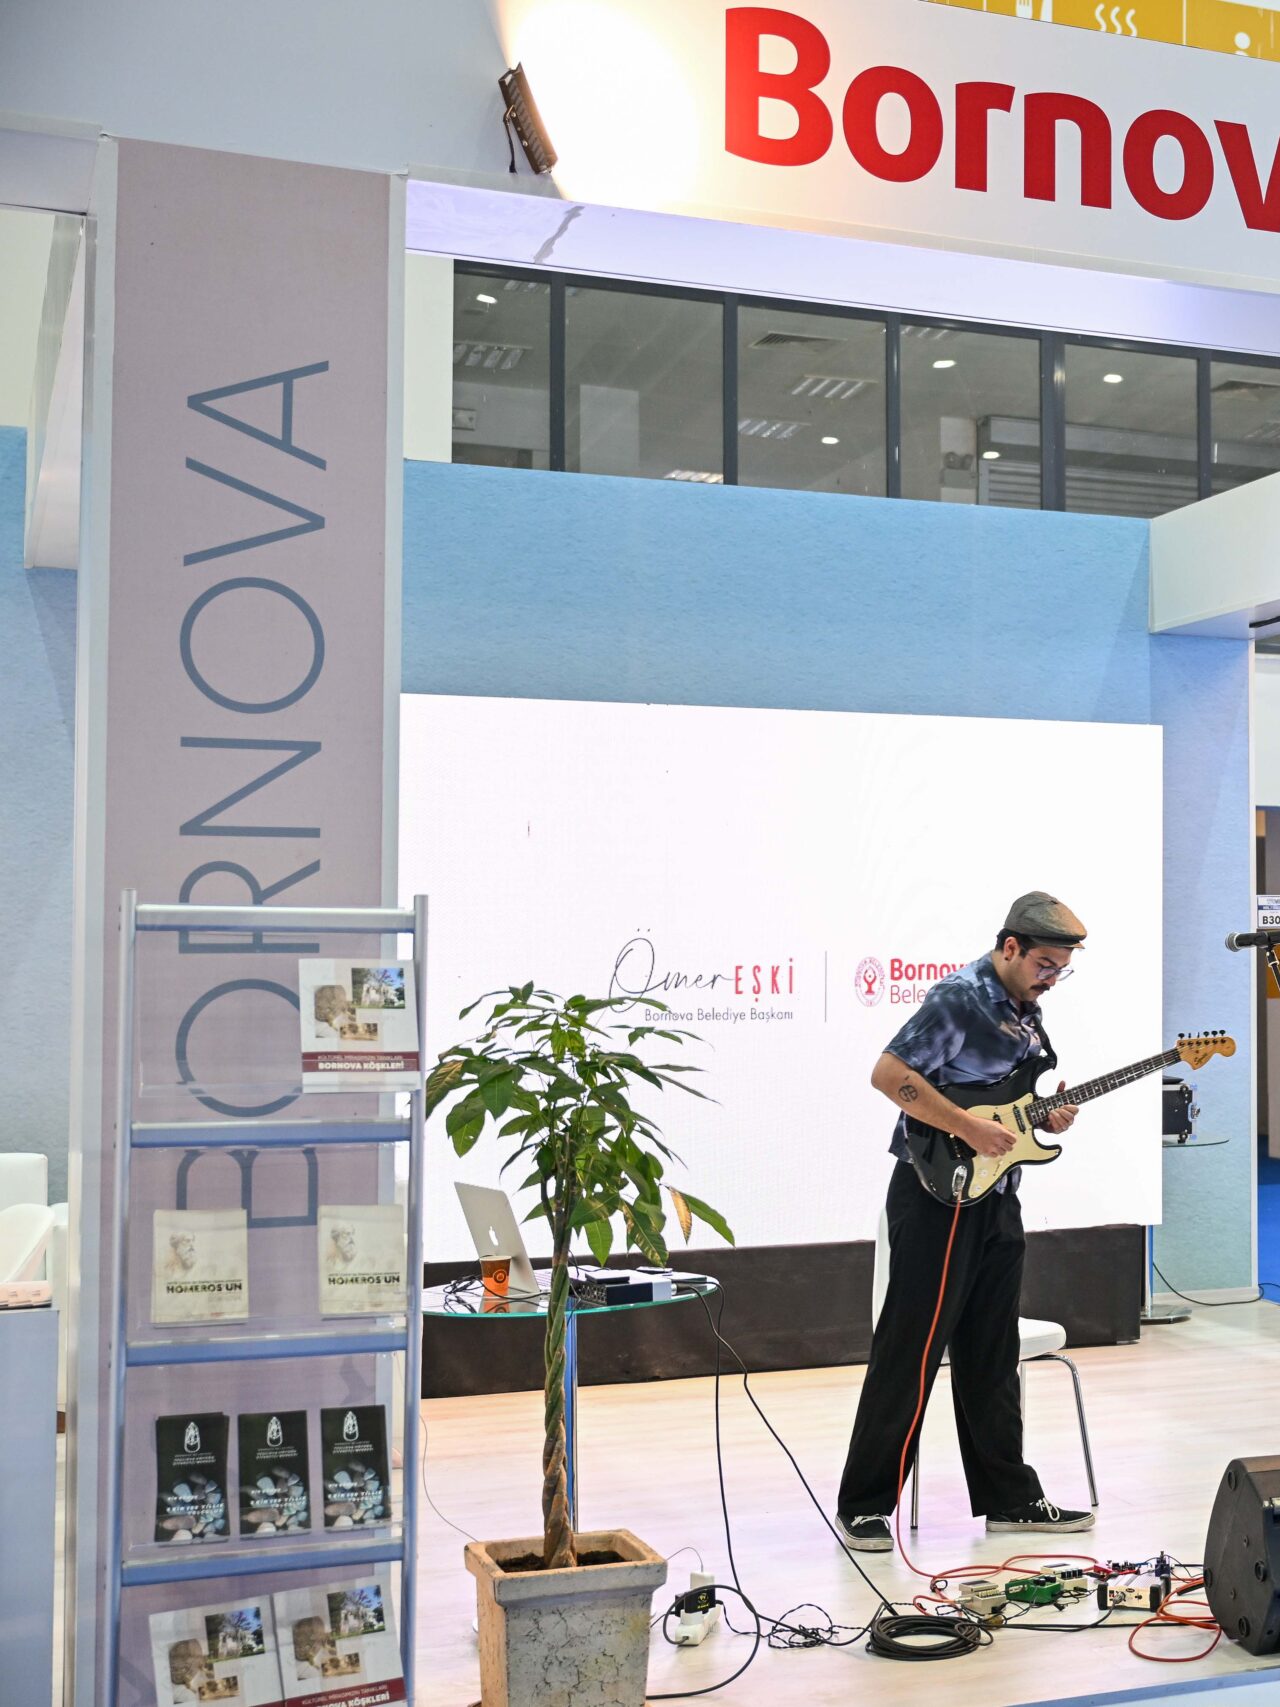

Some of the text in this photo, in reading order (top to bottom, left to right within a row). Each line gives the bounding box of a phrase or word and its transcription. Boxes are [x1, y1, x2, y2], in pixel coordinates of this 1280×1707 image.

[175, 360, 331, 1229] BORNOVA
[608, 928, 735, 1013] Ömer
[735, 958, 794, 1002] EŞKİ
[644, 1006, 794, 1024] Bornova Belediye Başkanı
[318, 1060, 405, 1071] BORNOVA KÖŞKLERİ
